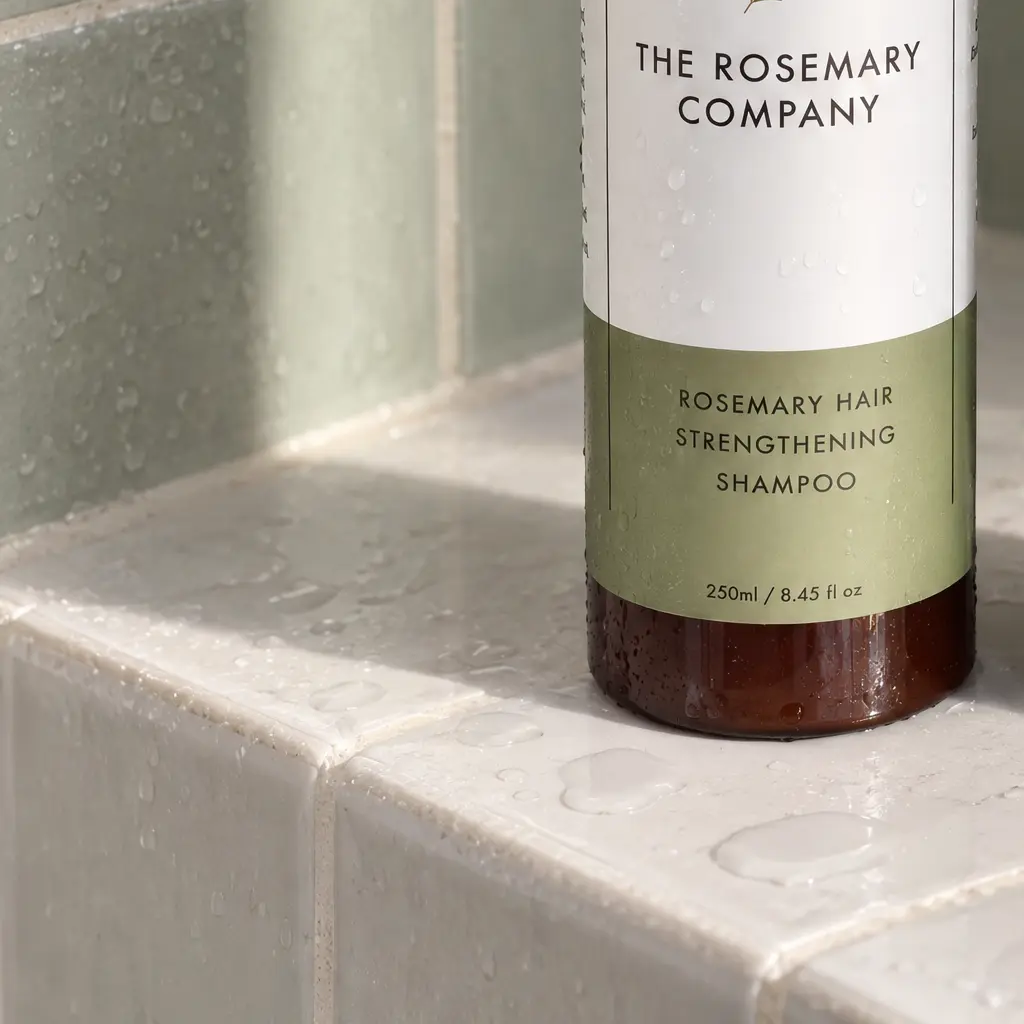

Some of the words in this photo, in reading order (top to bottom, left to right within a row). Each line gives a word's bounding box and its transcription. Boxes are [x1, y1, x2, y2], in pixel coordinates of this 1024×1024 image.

[636, 42, 693, 78] THE
[715, 41, 920, 83] ROSEMARY
[678, 94, 879, 128] COMPANY
[680, 389, 822, 416] ROSEMARY
[837, 386, 892, 412] HAIR
[676, 425, 895, 454] STRENGTHENING
[717, 472, 856, 494] SHAMPOO
[707, 584, 757, 602] 250ml
[764, 587, 776, 605] /
[781, 586, 819, 602] 8.45
[827, 584, 836, 599] fl
[843, 586, 862, 597] oz
